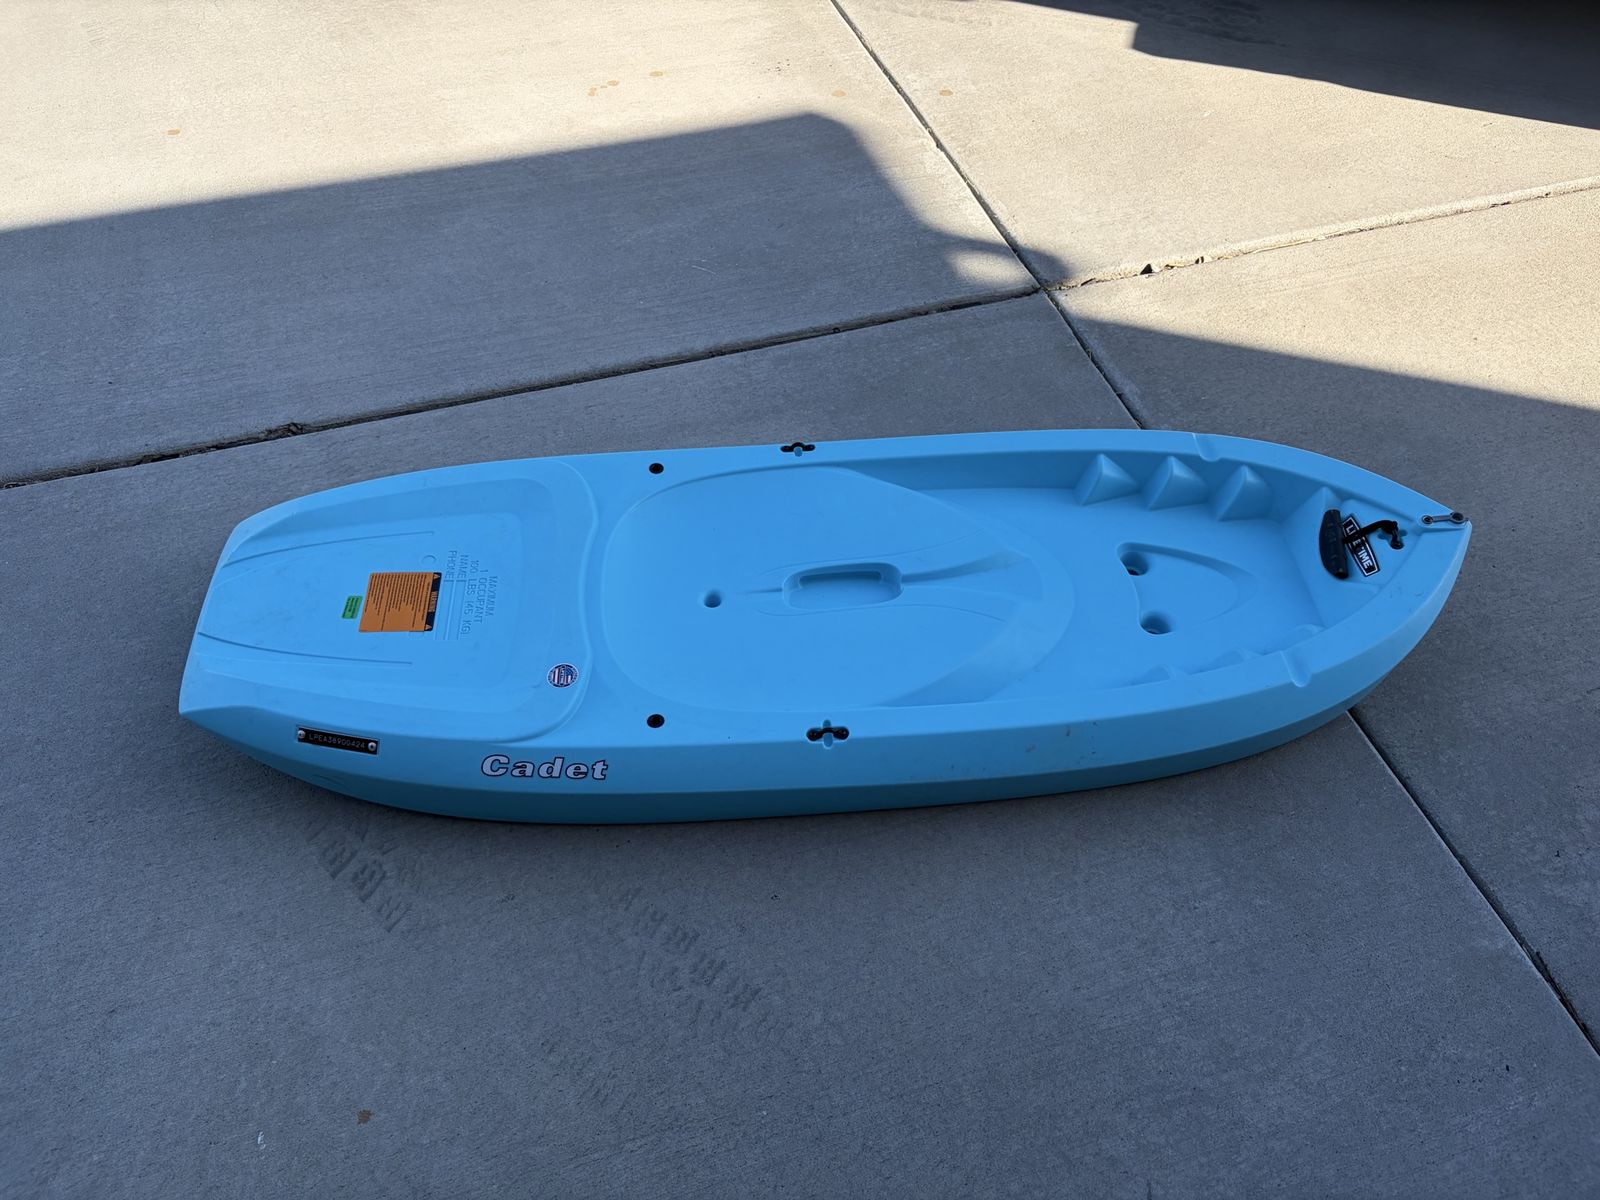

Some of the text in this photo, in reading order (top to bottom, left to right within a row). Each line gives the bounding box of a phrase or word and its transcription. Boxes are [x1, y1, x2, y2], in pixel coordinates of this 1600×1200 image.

[1345, 524, 1373, 569] LIEIME
[444, 550, 457, 579] PHONE
[466, 578, 477, 595] LBS
[473, 577, 487, 624] OCCUPANT
[485, 576, 498, 616] MAXIMUM
[481, 754, 608, 780] Cadet
